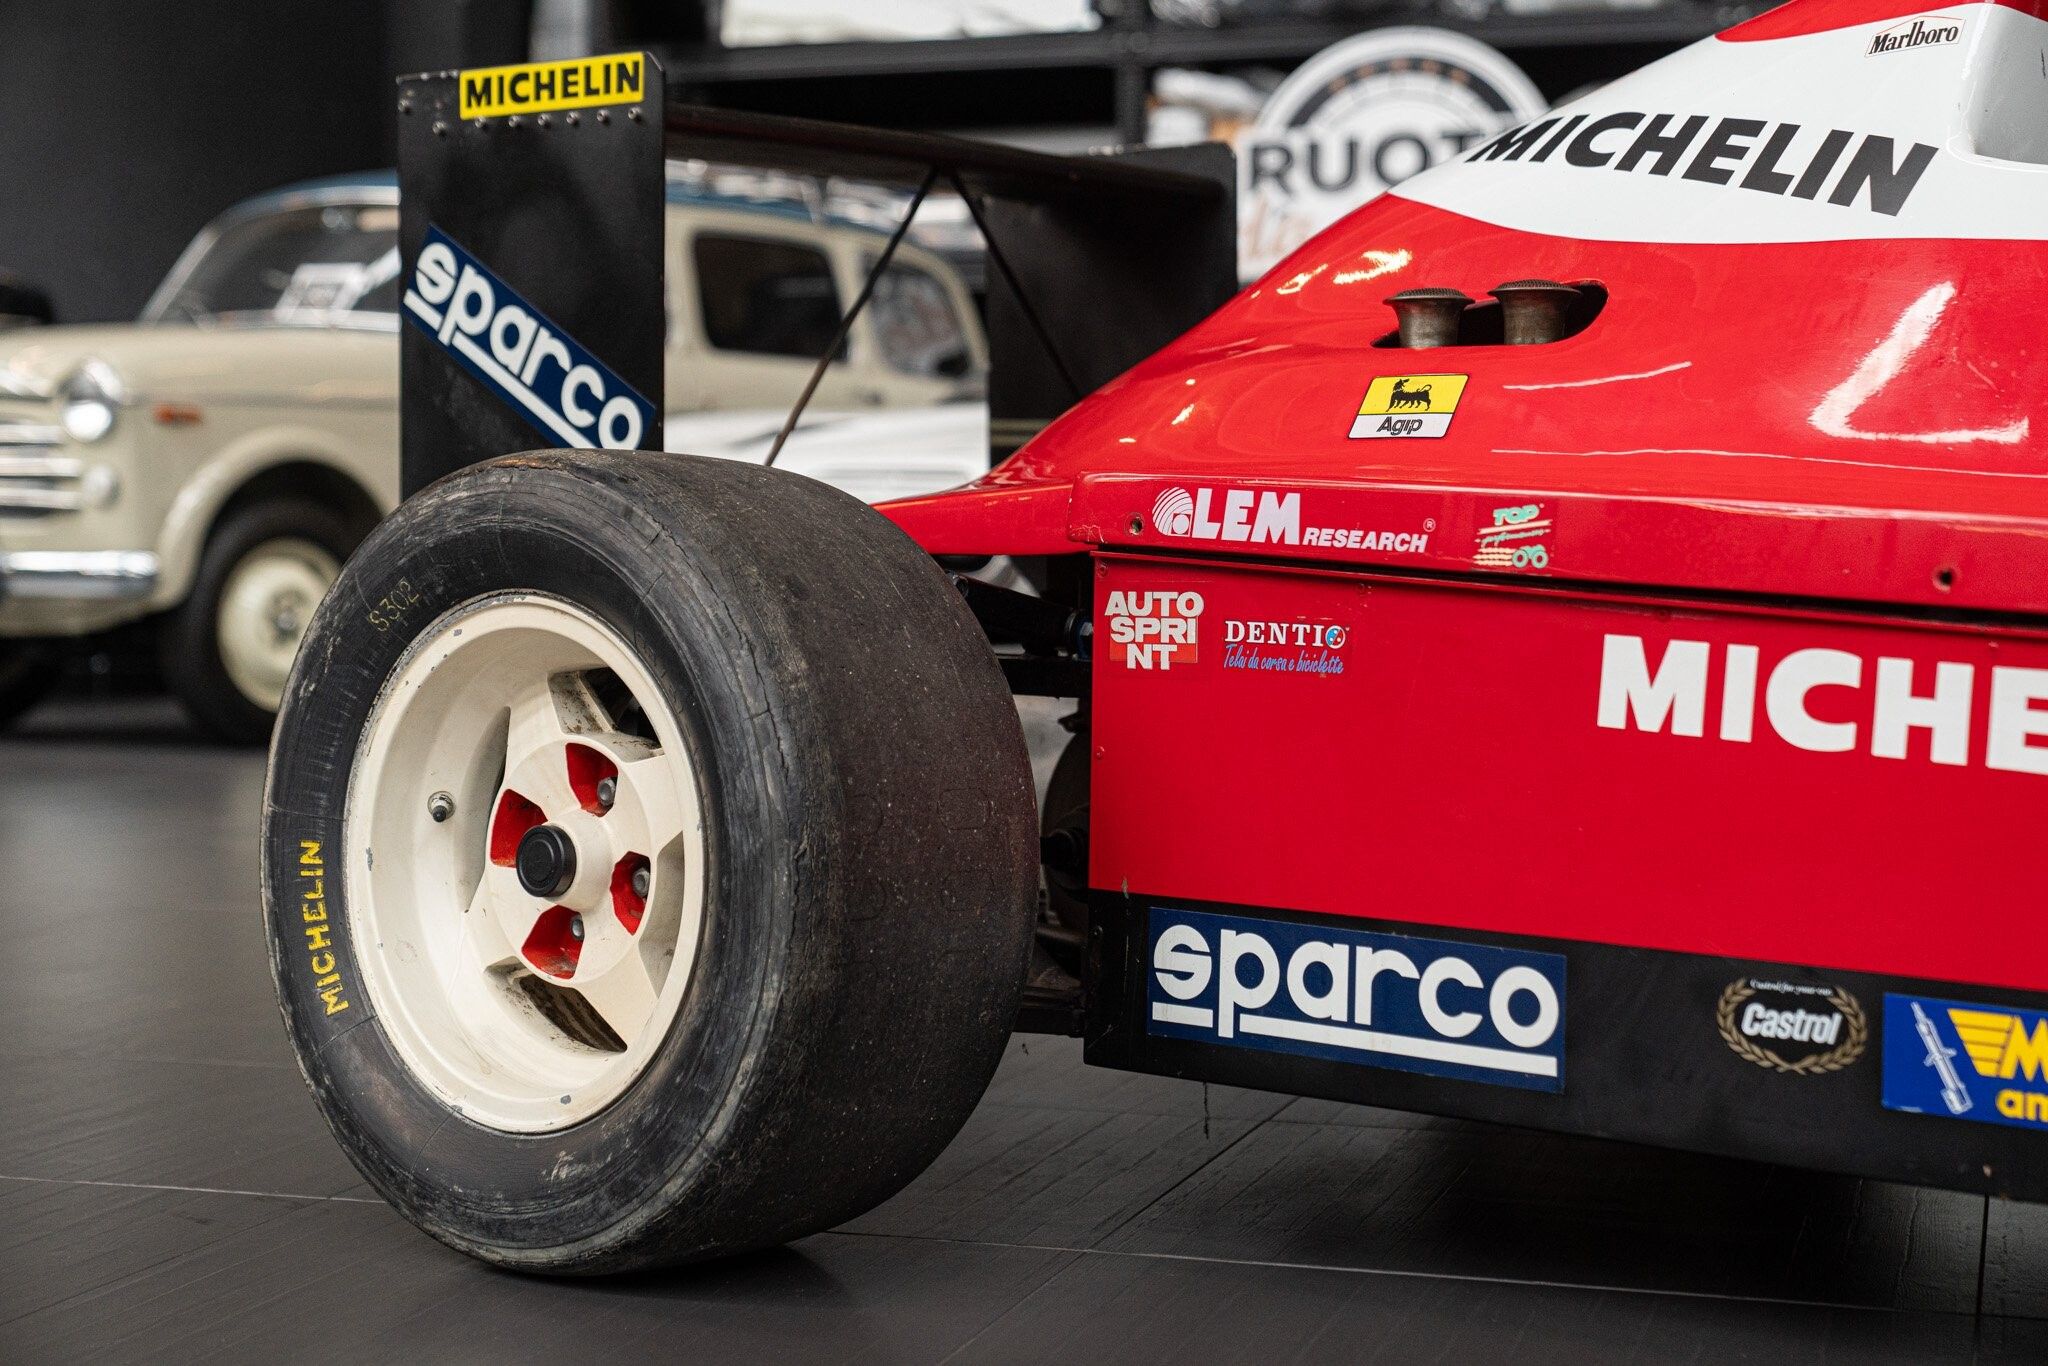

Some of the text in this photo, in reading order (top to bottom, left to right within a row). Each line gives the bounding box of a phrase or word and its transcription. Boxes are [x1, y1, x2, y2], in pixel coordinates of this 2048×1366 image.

[1868, 20, 1959, 54] Marlboro
[466, 59, 641, 109] MICHELIN
[1464, 111, 1939, 217] MICHELIN
[415, 242, 643, 449] sparco
[1376, 416, 1423, 436] Agip
[1192, 487, 1429, 553] LEM RESEARCH
[1493, 504, 1540, 526] TOP
[1104, 591, 1205, 618] AUTO
[1110, 617, 1198, 644] SPRI
[1126, 643, 1178, 670] NT
[1597, 634, 2048, 775] MICHE
[300, 840, 350, 1016] MICHELIN
[1153, 924, 1559, 1048] sparco
[1741, 1002, 1843, 1046] Castrol
